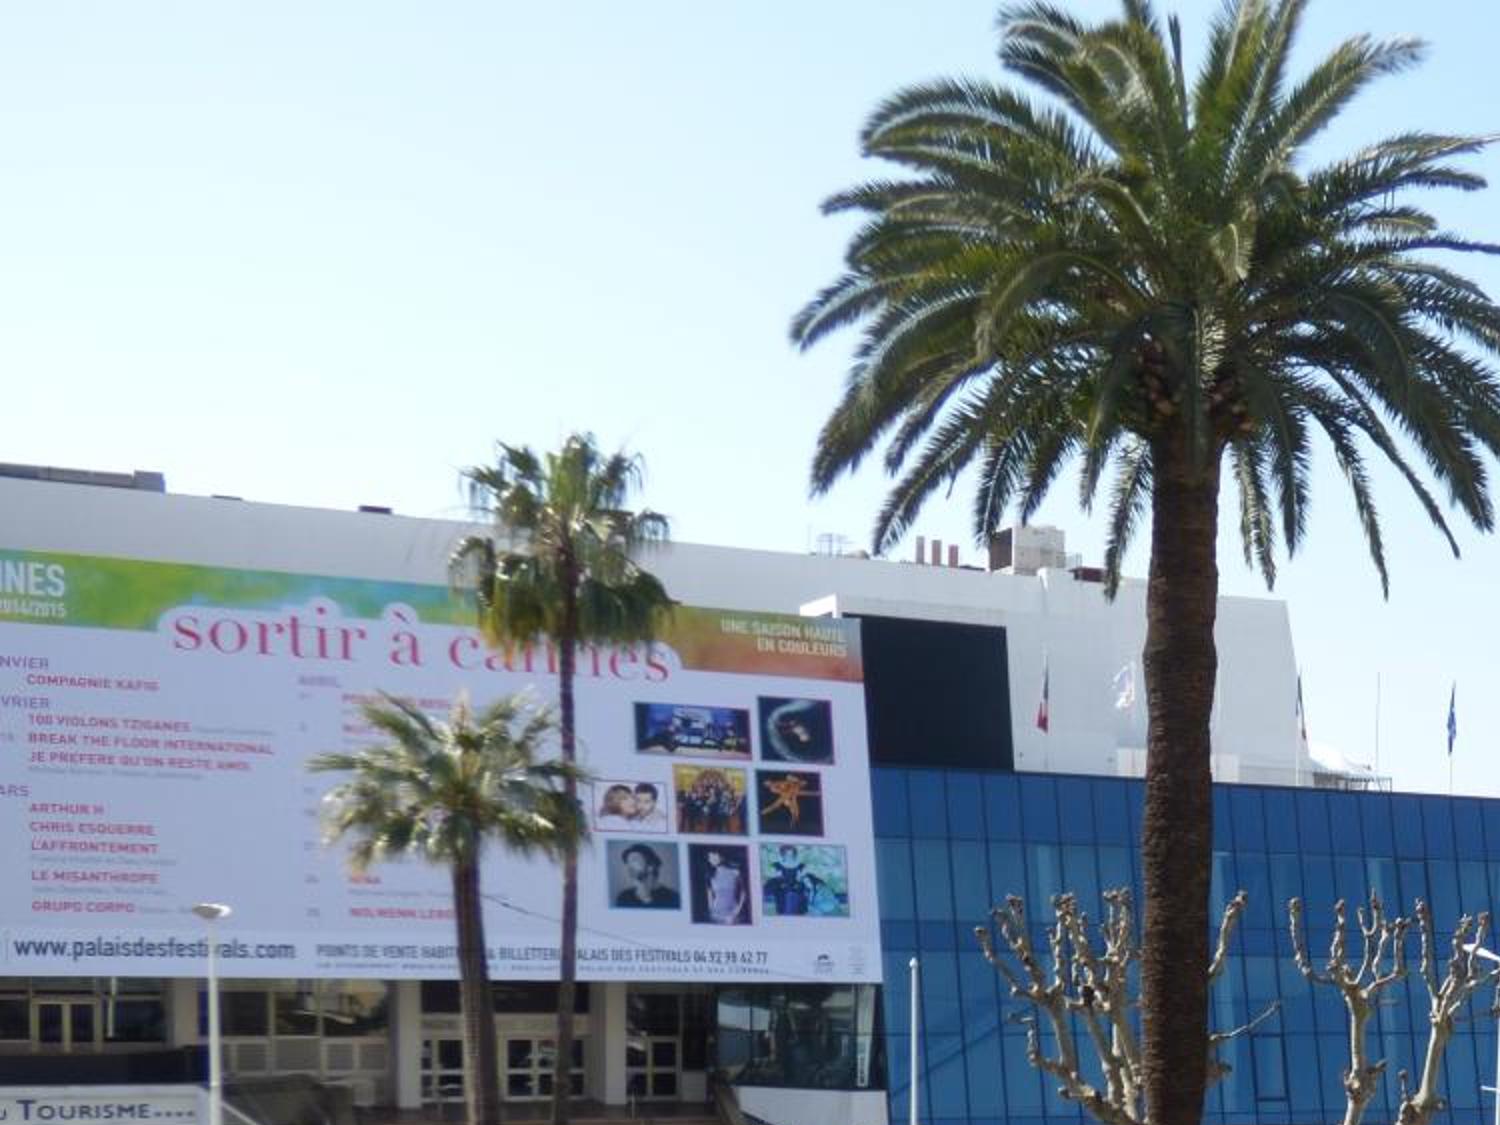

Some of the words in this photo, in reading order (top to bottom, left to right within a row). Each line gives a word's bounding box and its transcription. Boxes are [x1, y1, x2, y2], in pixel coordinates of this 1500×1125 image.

[173, 606, 367, 661] sortir
[389, 609, 423, 668] à
[721, 616, 748, 634] UNE
[752, 620, 801, 639] SAISON
[804, 624, 846, 642] HAUTE
[757, 638, 775, 652] EN
[778, 639, 847, 657] COULEURS
[27, 673, 112, 690] COMPAGNIE
[55, 716, 118, 729] VIOLONS
[28, 732, 76, 745] BREAK
[82, 734, 108, 747] THE
[113, 736, 159, 749] FLOOR
[163, 739, 274, 756] INTERNATIONAL
[30, 752, 48, 763] JE
[30, 802, 91, 815] ARTHUR
[30, 821, 74, 833] CHRIS
[78, 823, 156, 837] ESQUERRE
[31, 839, 159, 854] L'AFFRONTEMENT
[31, 870, 48, 881] LE
[51, 871, 160, 884] MISANTHROPE
[31, 900, 82, 913] GRUPO
[316, 943, 359, 958] POINTS
[362, 944, 378, 958] DE
[383, 945, 418, 959] VENTE
[421, 946, 457, 960] HABIT
[499, 947, 561, 960] BILLETTERI
[577, 948, 609, 961] ALAIS
[611, 949, 633, 962] DES
[635, 950, 692, 963] FESTIVALS
